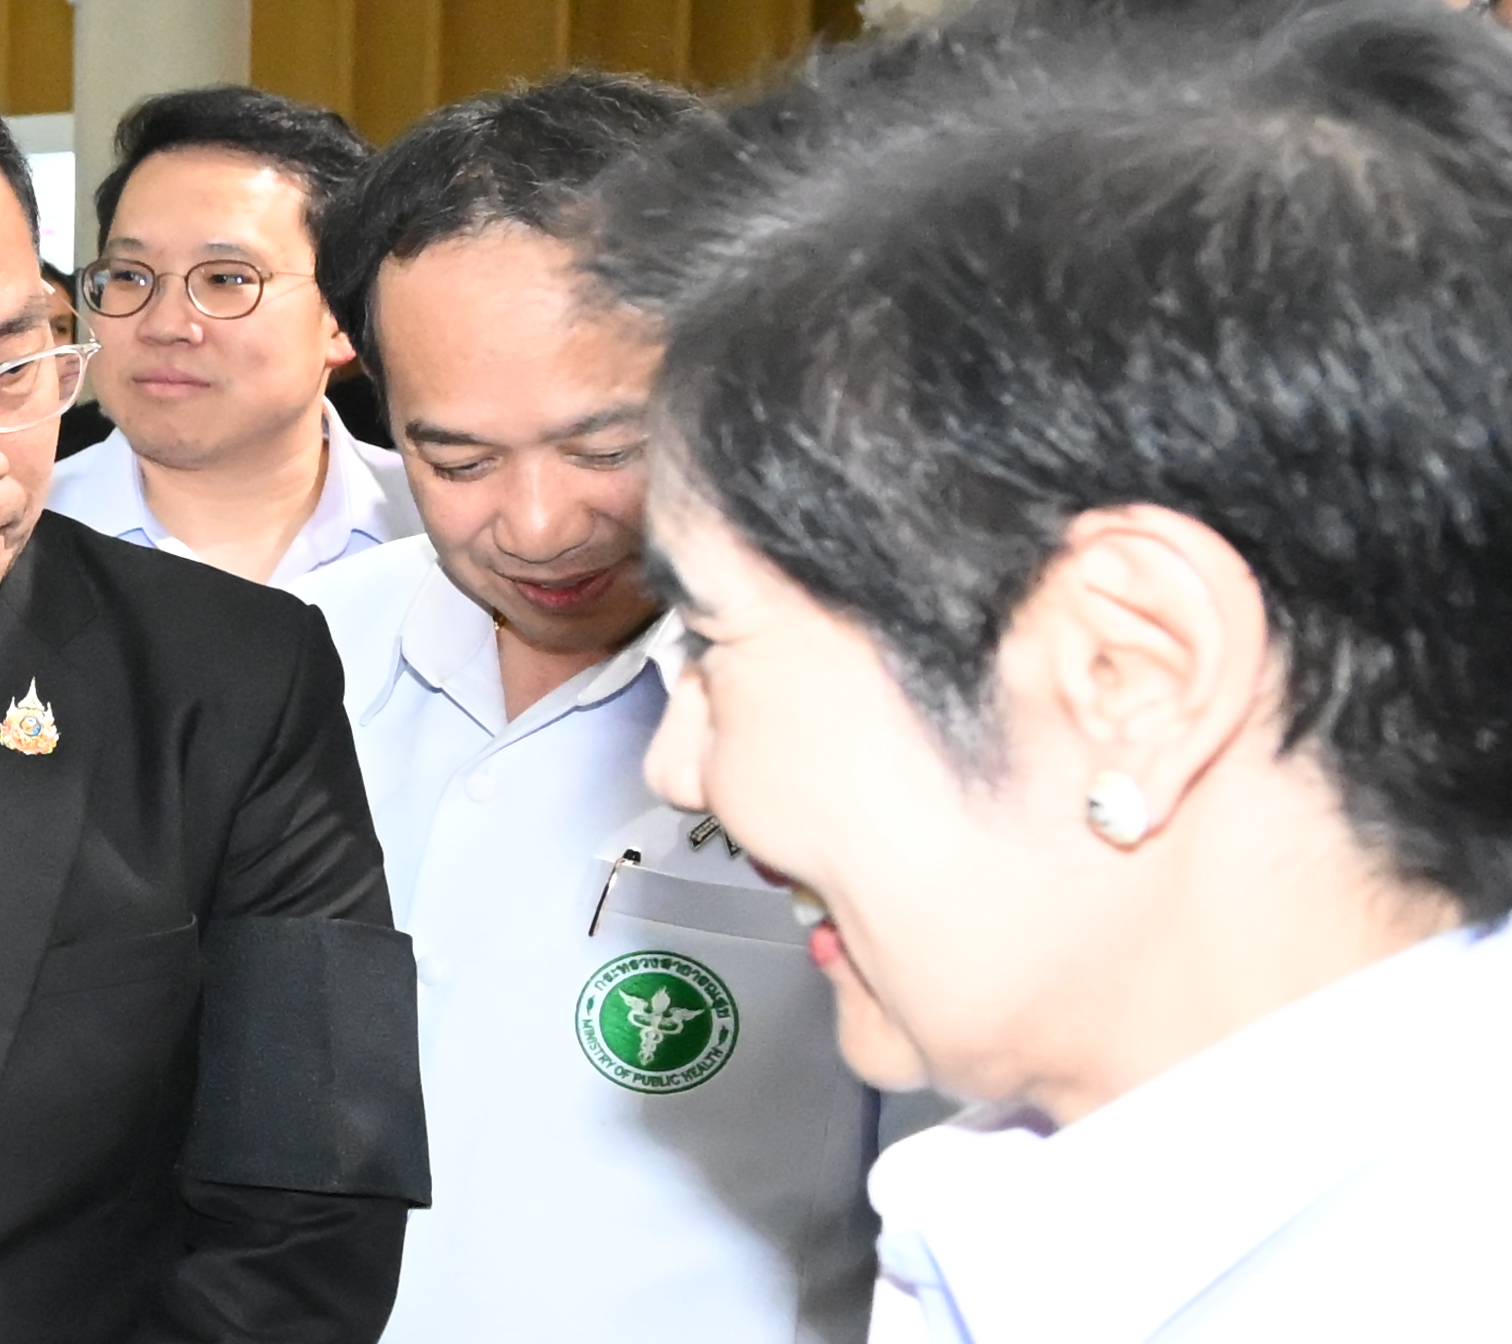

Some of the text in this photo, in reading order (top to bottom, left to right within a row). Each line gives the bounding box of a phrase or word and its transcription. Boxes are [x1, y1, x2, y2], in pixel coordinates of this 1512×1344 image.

[582, 1018, 725, 1089] MINISTRY OF PUBLIC HEALTH
